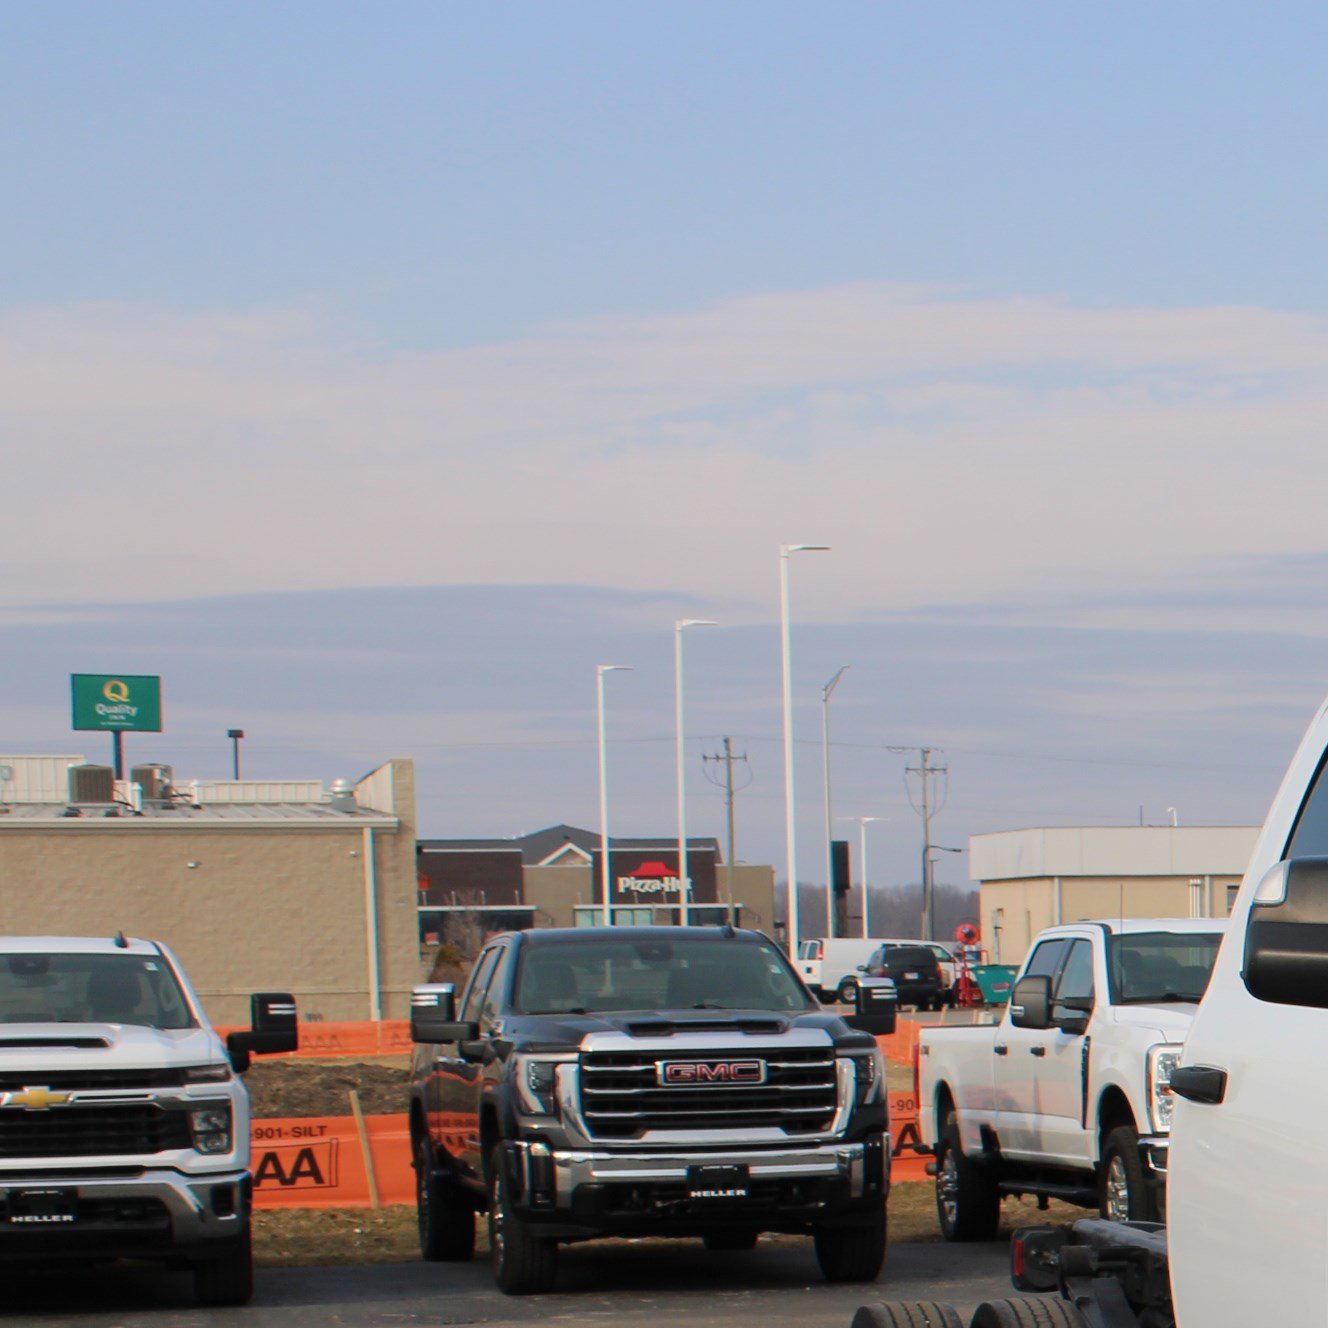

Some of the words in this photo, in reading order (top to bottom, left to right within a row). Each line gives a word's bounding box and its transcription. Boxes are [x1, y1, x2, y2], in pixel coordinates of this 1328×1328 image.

[95, 703, 138, 717] Quality
[666, 1063, 759, 1082] GMC
[690, 1189, 746, 1197] HELLER
[10, 1215, 74, 1223] HELLER
